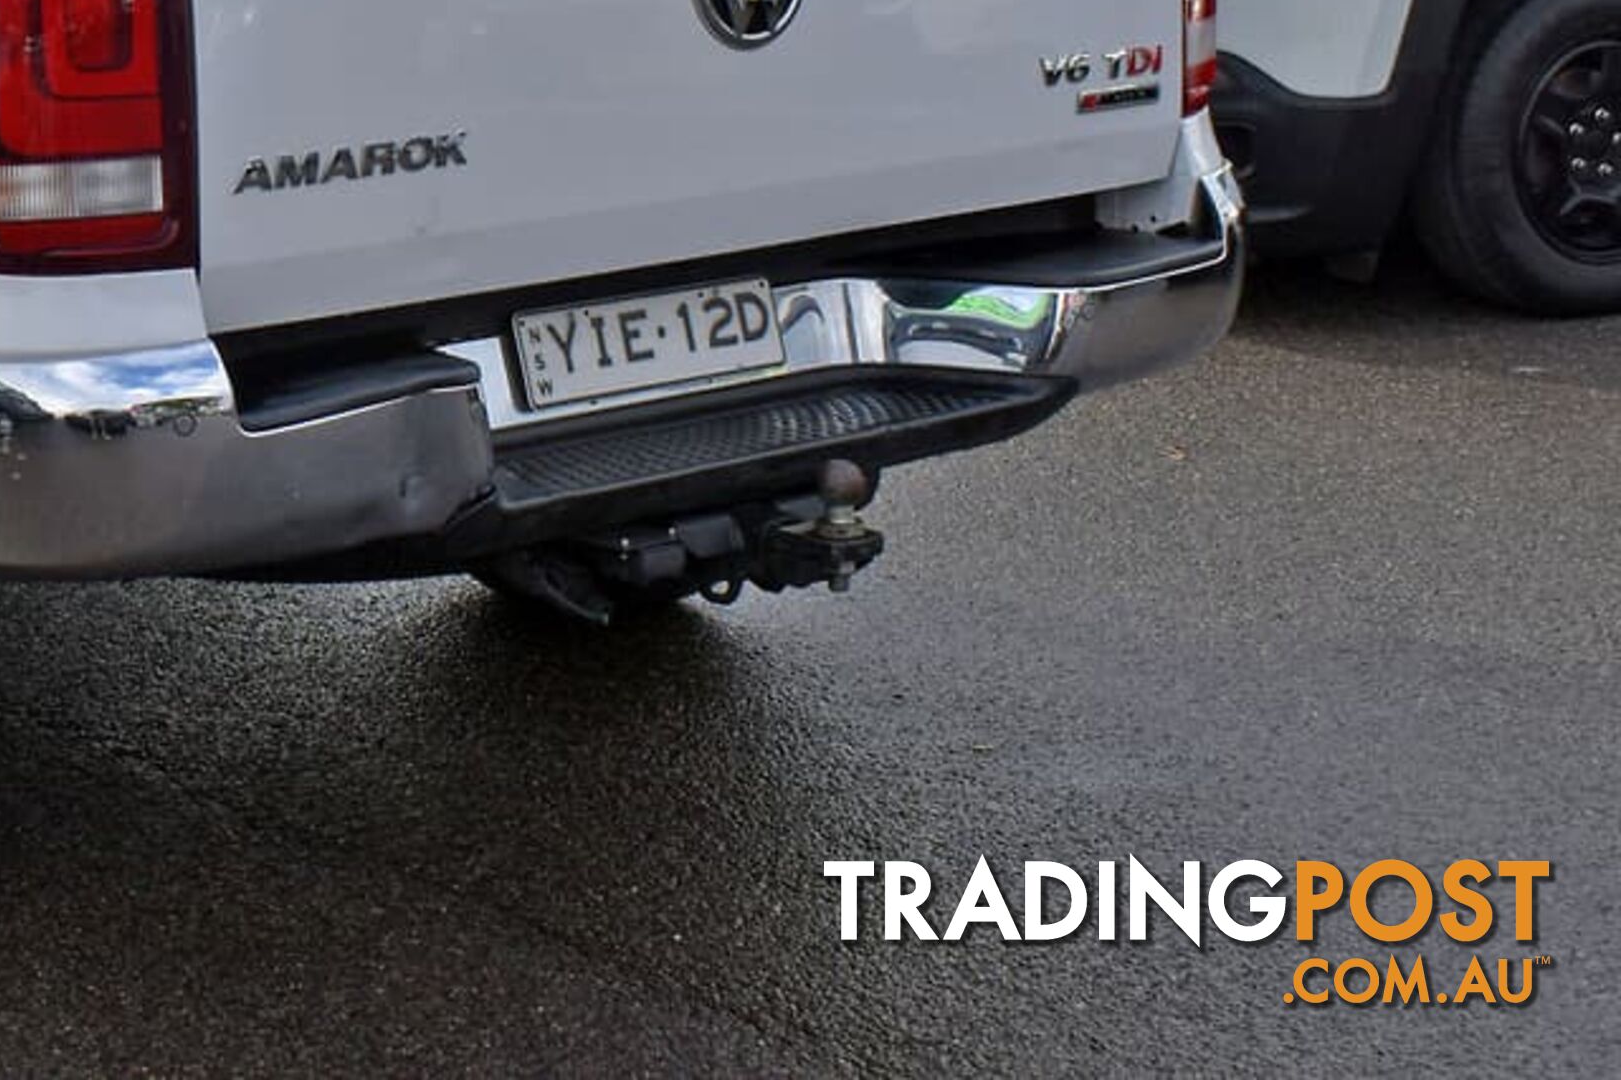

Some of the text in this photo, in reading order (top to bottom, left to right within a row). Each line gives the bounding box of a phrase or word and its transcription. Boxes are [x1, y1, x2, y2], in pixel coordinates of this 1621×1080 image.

[1039, 43, 1163, 88] V6 TDI
[233, 129, 468, 195] AMAROK
